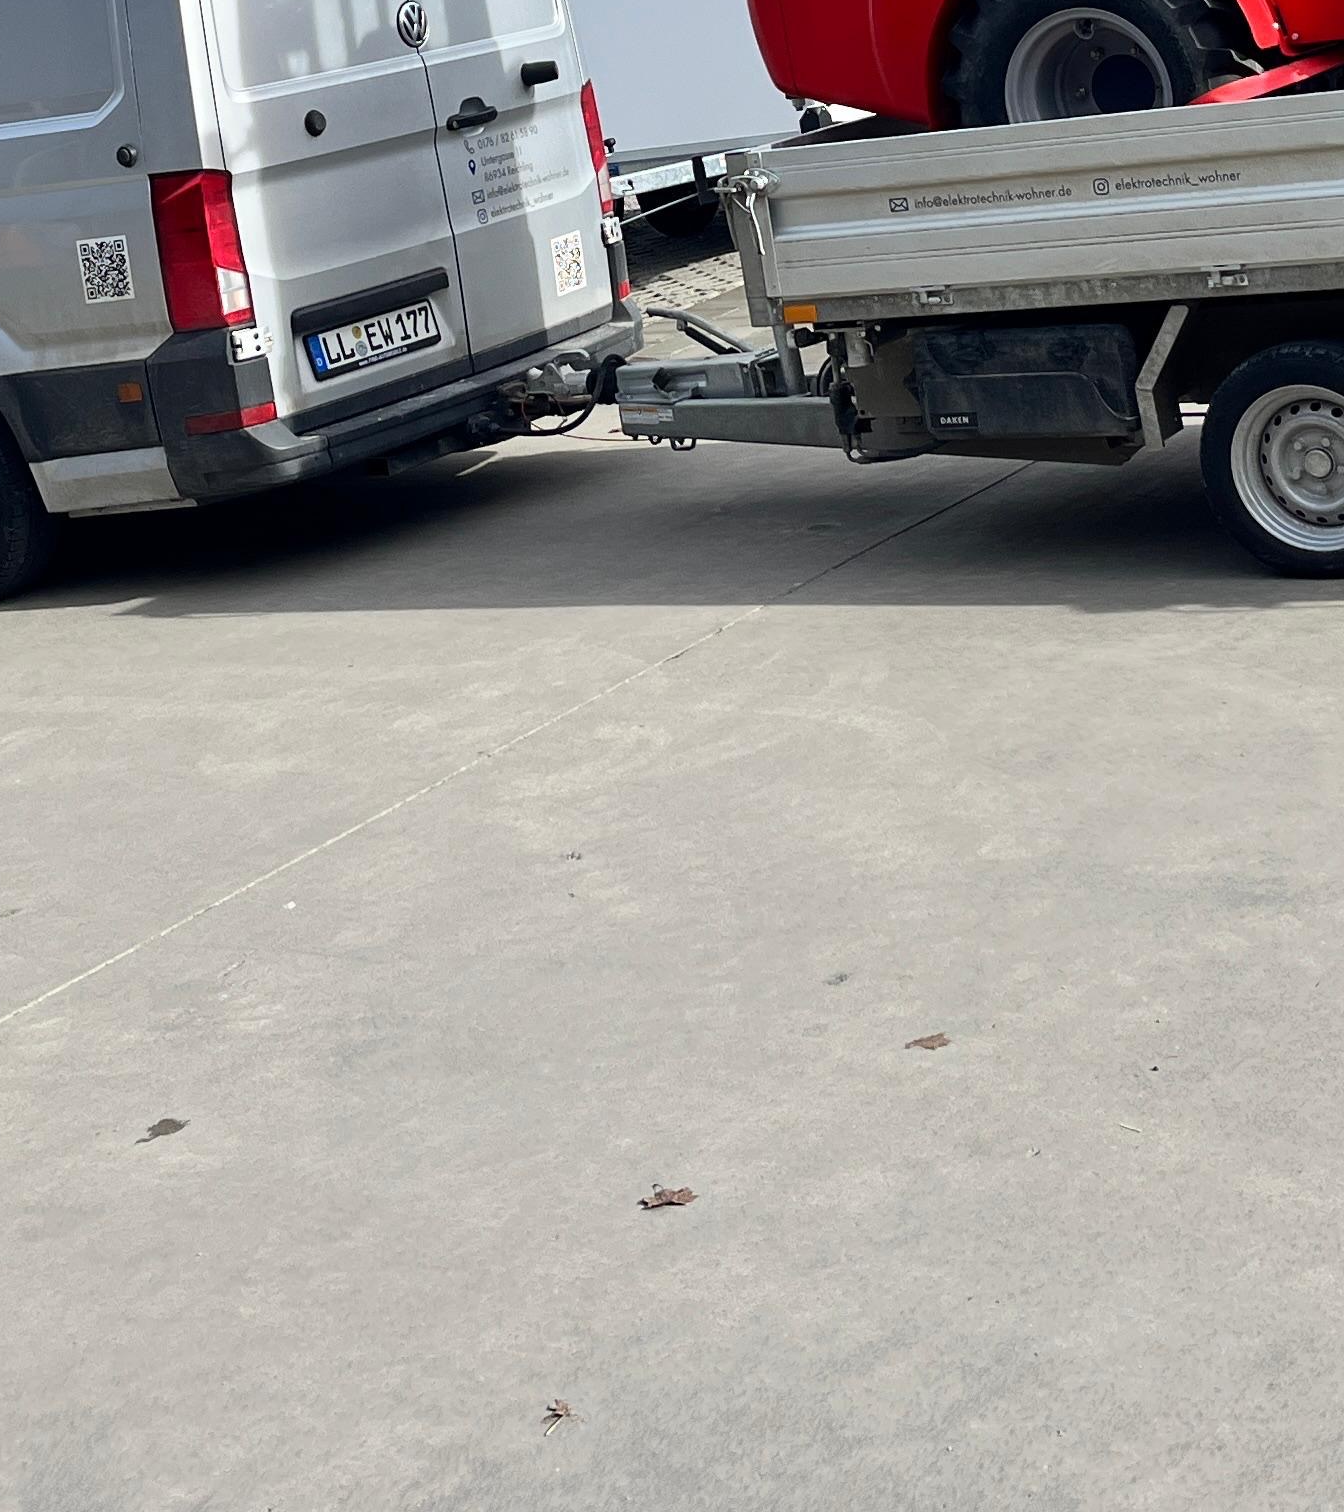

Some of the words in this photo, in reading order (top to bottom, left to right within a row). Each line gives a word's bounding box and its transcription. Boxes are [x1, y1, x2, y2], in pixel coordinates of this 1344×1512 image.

[1114, 170, 1241, 191] elektrotechnik_wohner
[914, 184, 1072, 209] info@elektrotechnik-wohner.de
[322, 332, 356, 365] LL
[364, 317, 395, 351] EW
[395, 306, 430, 341] 177
